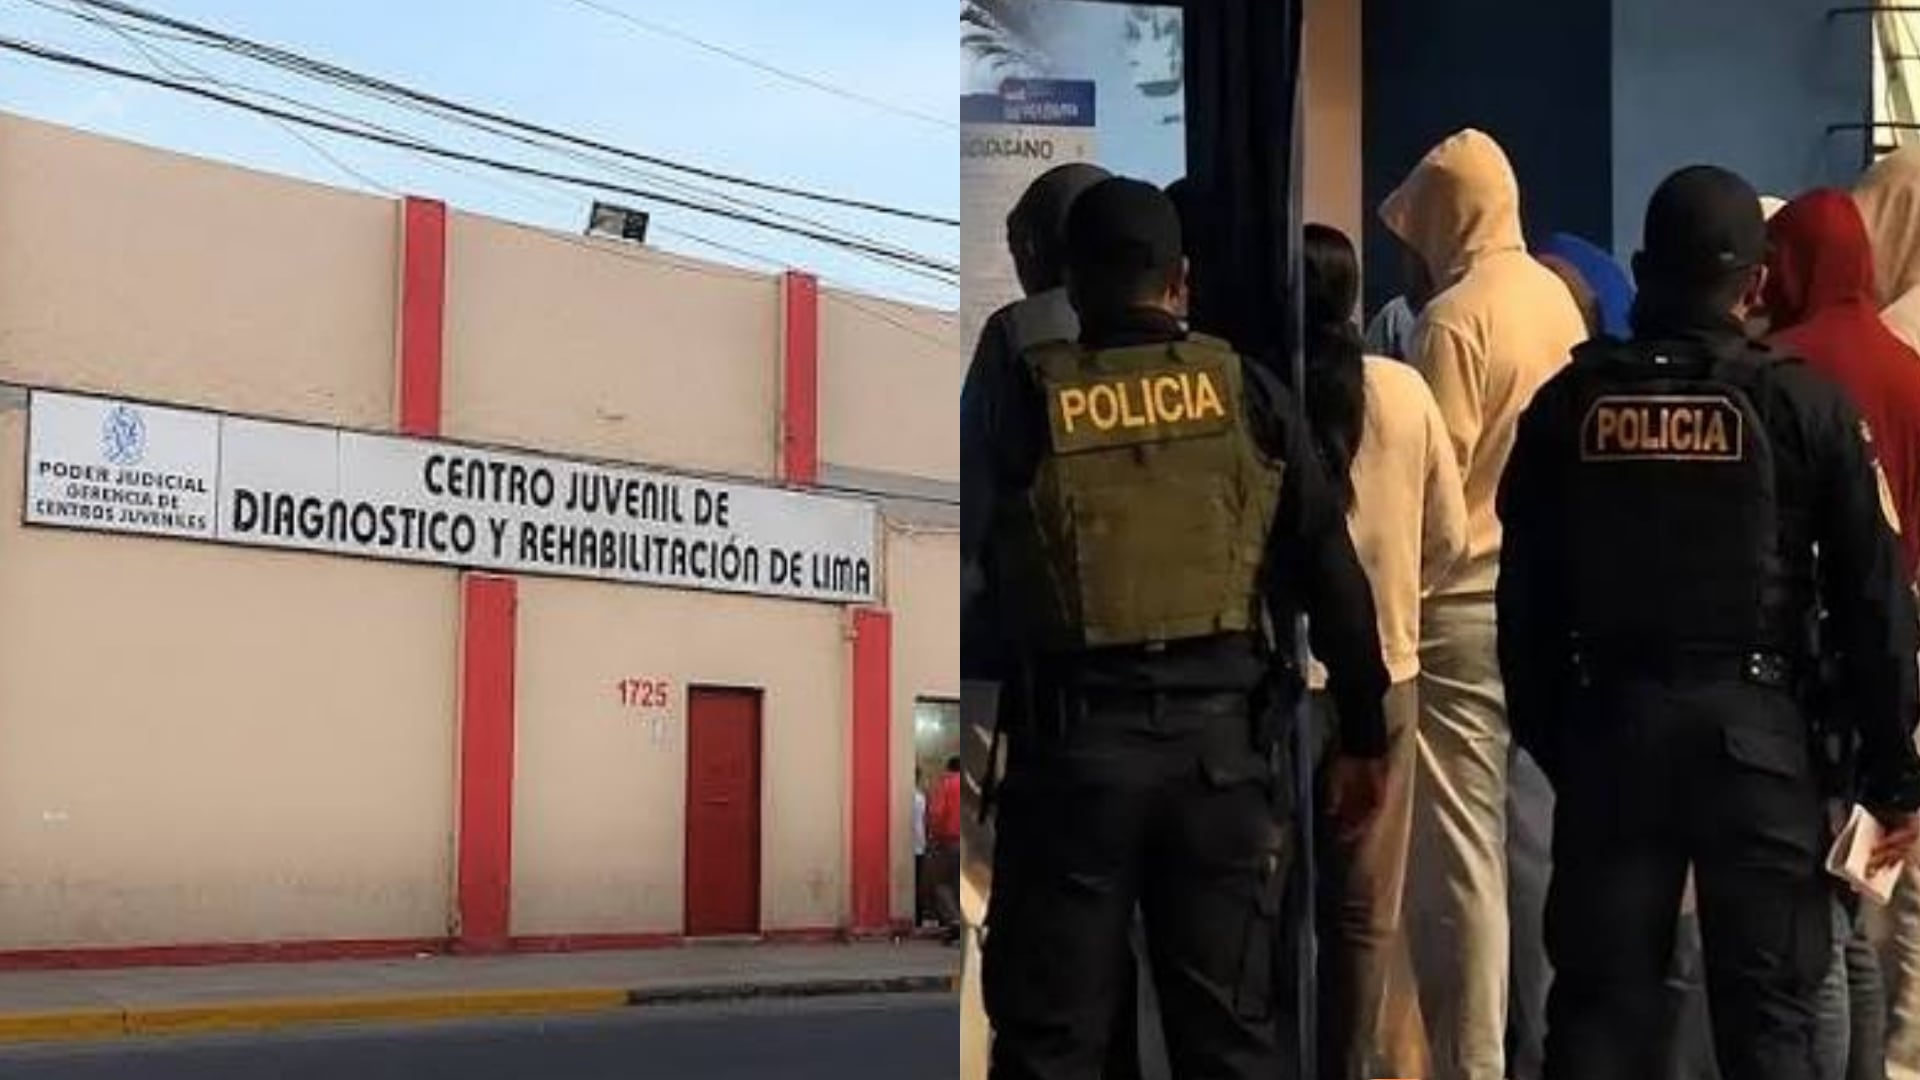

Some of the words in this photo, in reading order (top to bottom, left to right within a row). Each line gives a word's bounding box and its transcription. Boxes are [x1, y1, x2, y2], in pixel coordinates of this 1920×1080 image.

[1060, 372, 1225, 433] POLICIA
[1597, 407, 1729, 451] POLICIA
[39, 461, 110, 483] PODER
[115, 468, 208, 493] JUDICIAL
[424, 454, 556, 507] CENTRO
[565, 470, 684, 524] JUVENIL
[694, 488, 729, 528] DE
[36, 499, 115, 522] CENTROS
[119, 510, 207, 530] JUVENILES
[66, 483, 153, 506] GERENCIA
[158, 495, 179, 510] DE
[233, 488, 476, 554] DIAGNOSTICO
[488, 516, 509, 558] Y
[520, 521, 760, 585] REHABILITACIÓN
[770, 548, 802, 586] DE
[812, 553, 871, 595] LIMA
[617, 679, 668, 707] 1725
